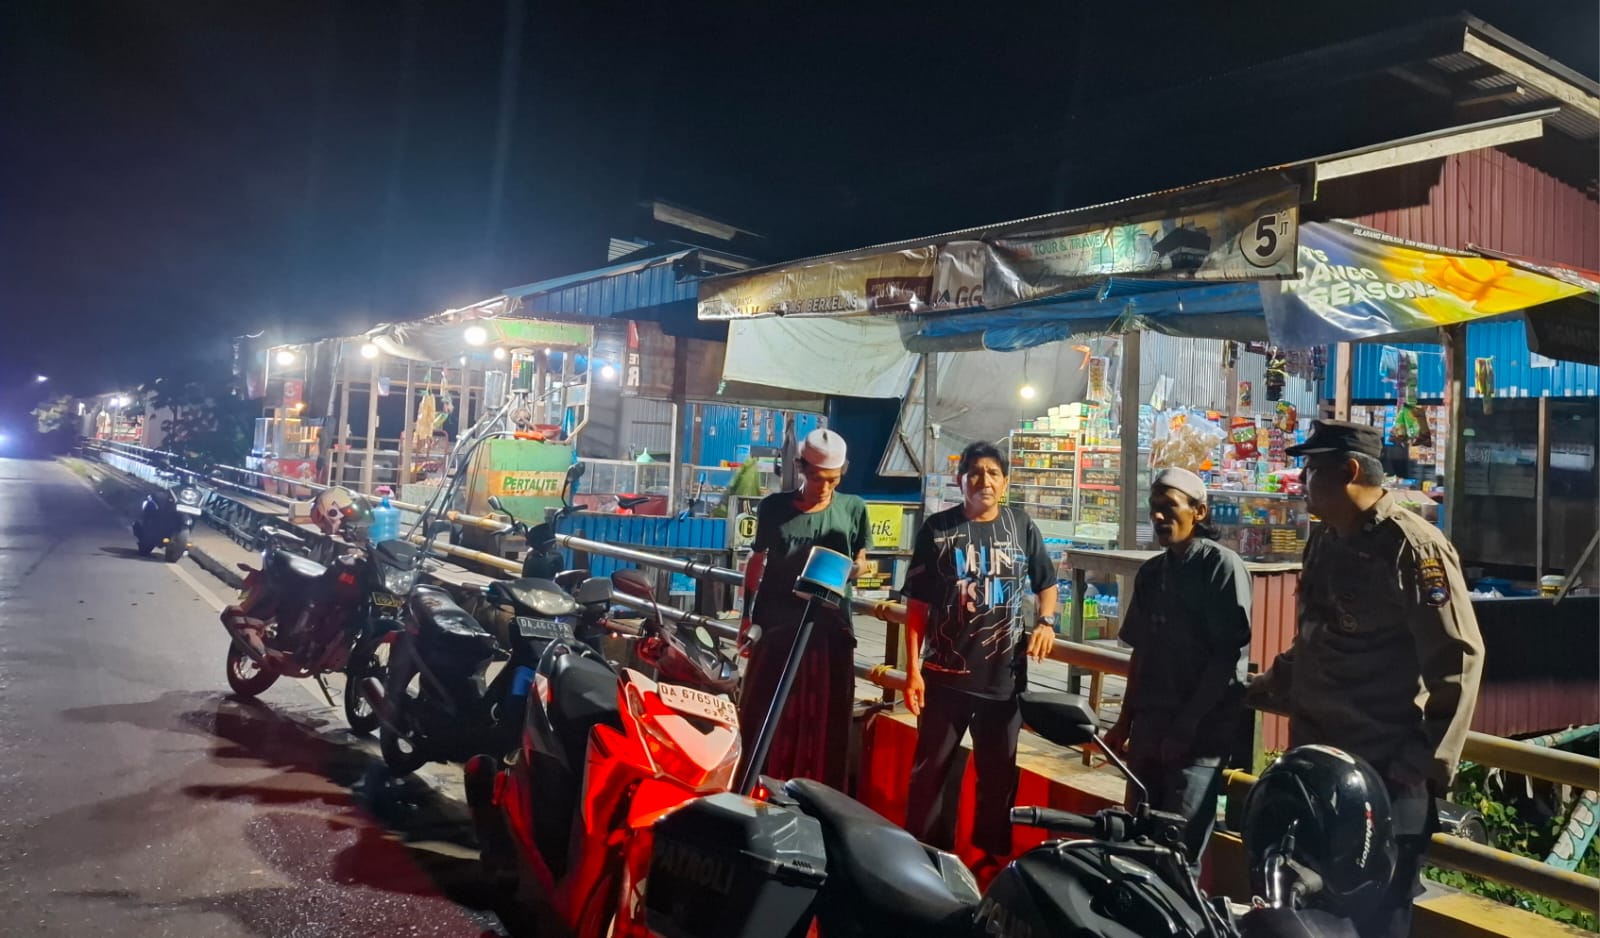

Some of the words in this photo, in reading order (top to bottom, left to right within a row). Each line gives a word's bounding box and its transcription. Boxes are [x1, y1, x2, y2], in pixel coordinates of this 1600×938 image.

[1255, 215, 1277, 257] 5
[1034, 241, 1058, 256] TOUR
[503, 476, 557, 490] PERTALITE
[871, 519, 893, 537] tik
[661, 685, 676, 697] DA
[681, 688, 711, 705] 6765
[712, 696, 735, 714] UAS
